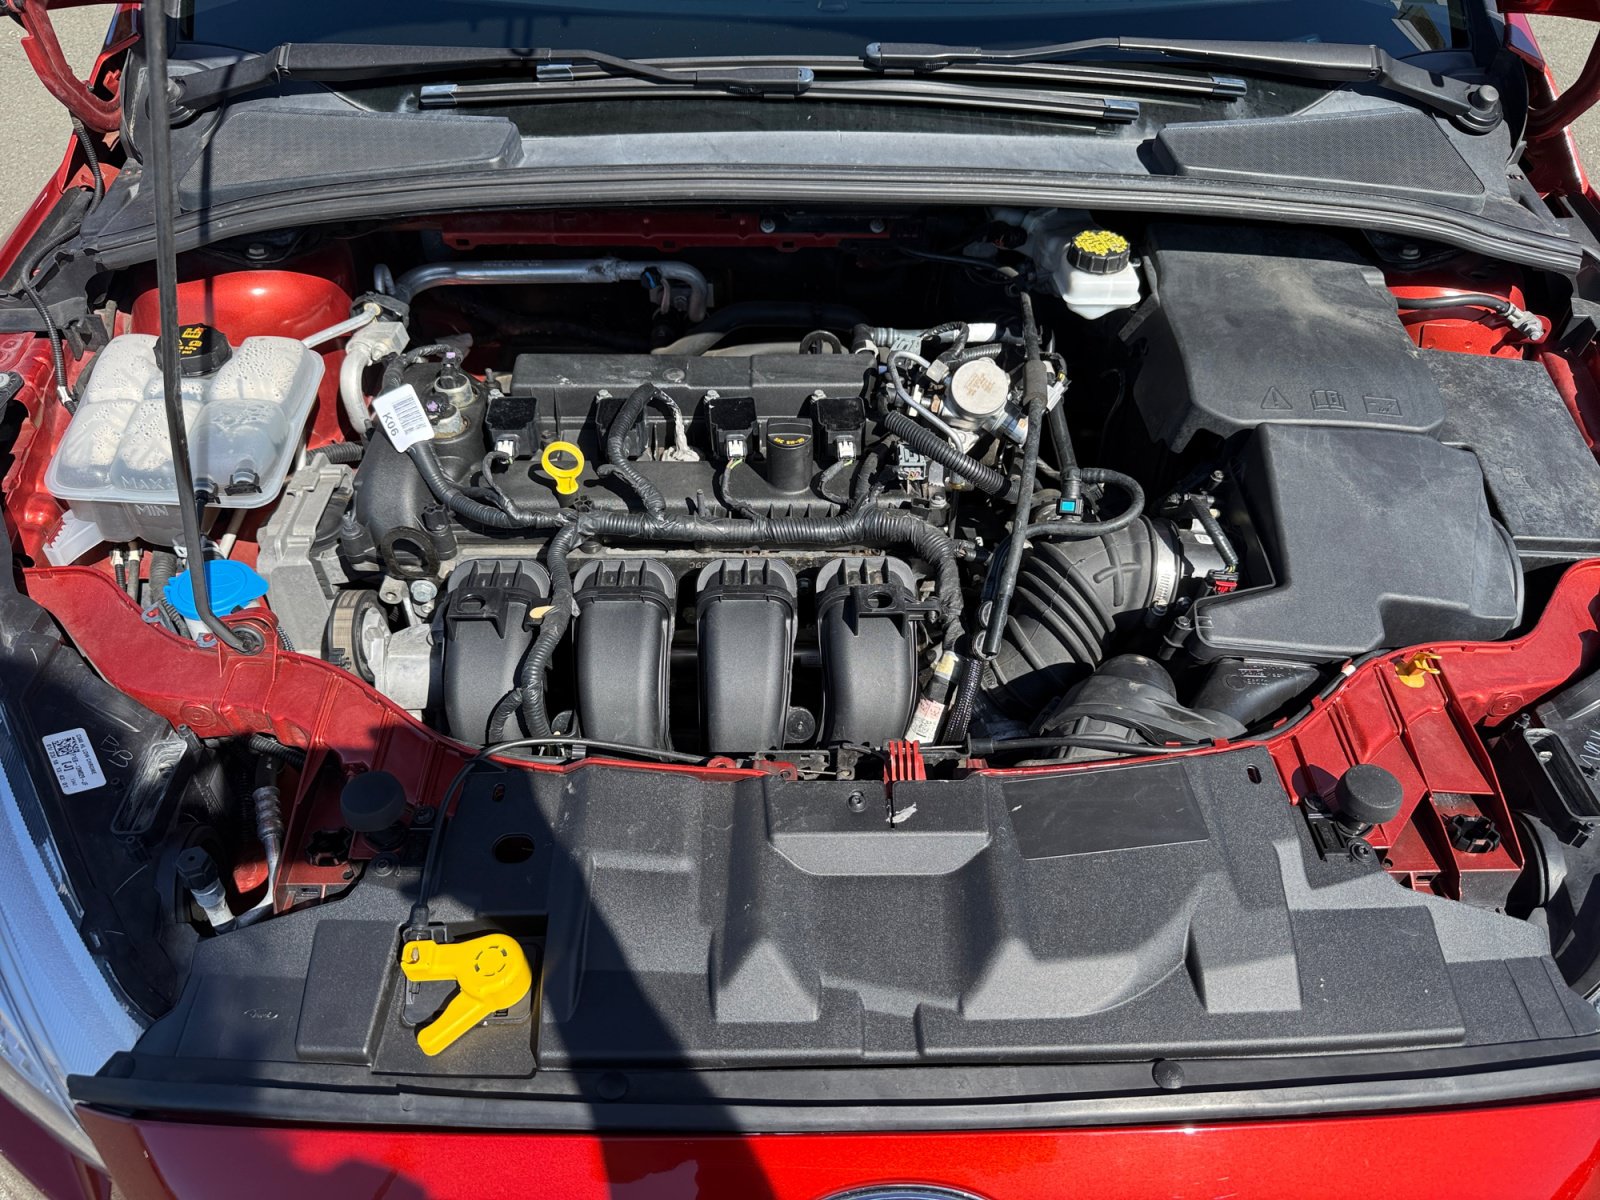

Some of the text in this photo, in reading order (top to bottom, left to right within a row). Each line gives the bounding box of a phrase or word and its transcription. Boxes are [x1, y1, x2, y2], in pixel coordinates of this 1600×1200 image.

[382, 412, 400, 437] K06
[120, 475, 165, 490] MAX
[135, 503, 169, 517] MIN
